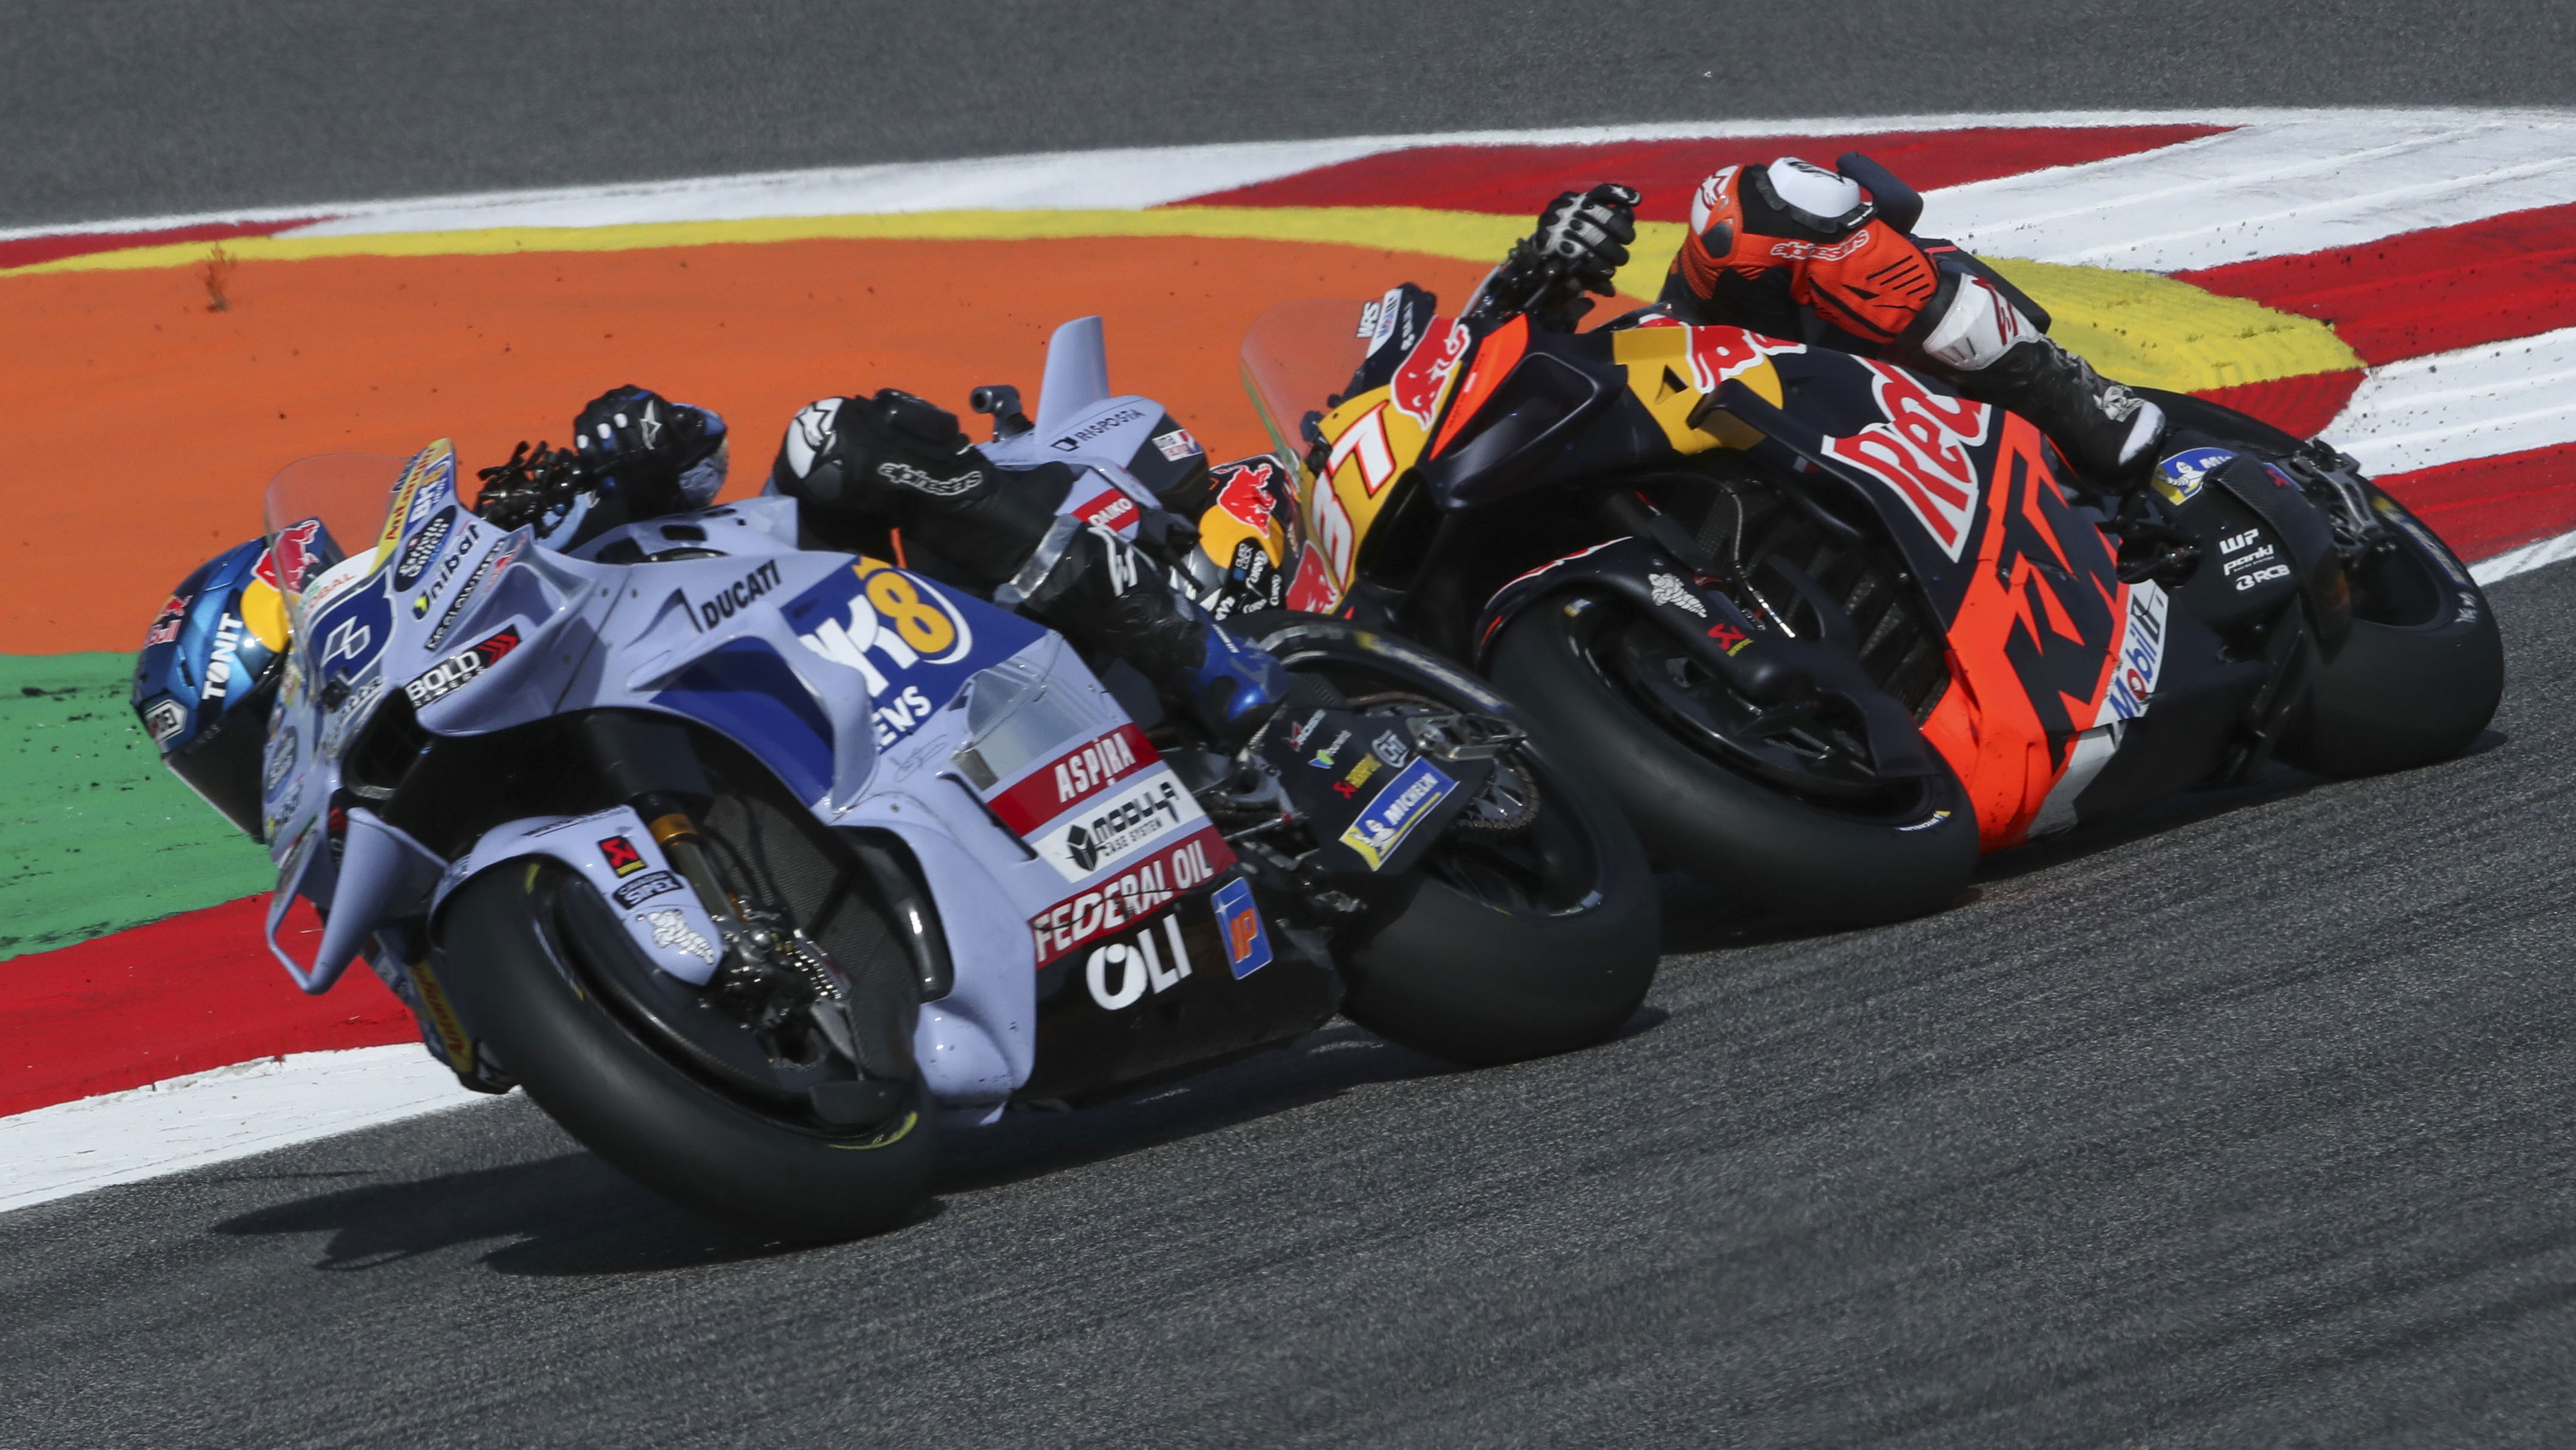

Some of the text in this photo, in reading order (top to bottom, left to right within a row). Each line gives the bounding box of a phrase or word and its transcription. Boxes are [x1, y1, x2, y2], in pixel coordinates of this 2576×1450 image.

[1356, 301, 1380, 338] WRS
[1074, 408, 1146, 441] RISPOSTA
[1087, 497, 1134, 527] DAIKO
[701, 559, 782, 630] DUCATI
[405, 651, 481, 702] BOLD
[2109, 621, 2157, 720] Mobil
[1383, 772, 1439, 826] MICHELIN
[1035, 840, 1214, 963] FEDERAL OIL
[1086, 913, 1193, 1011] OLI
